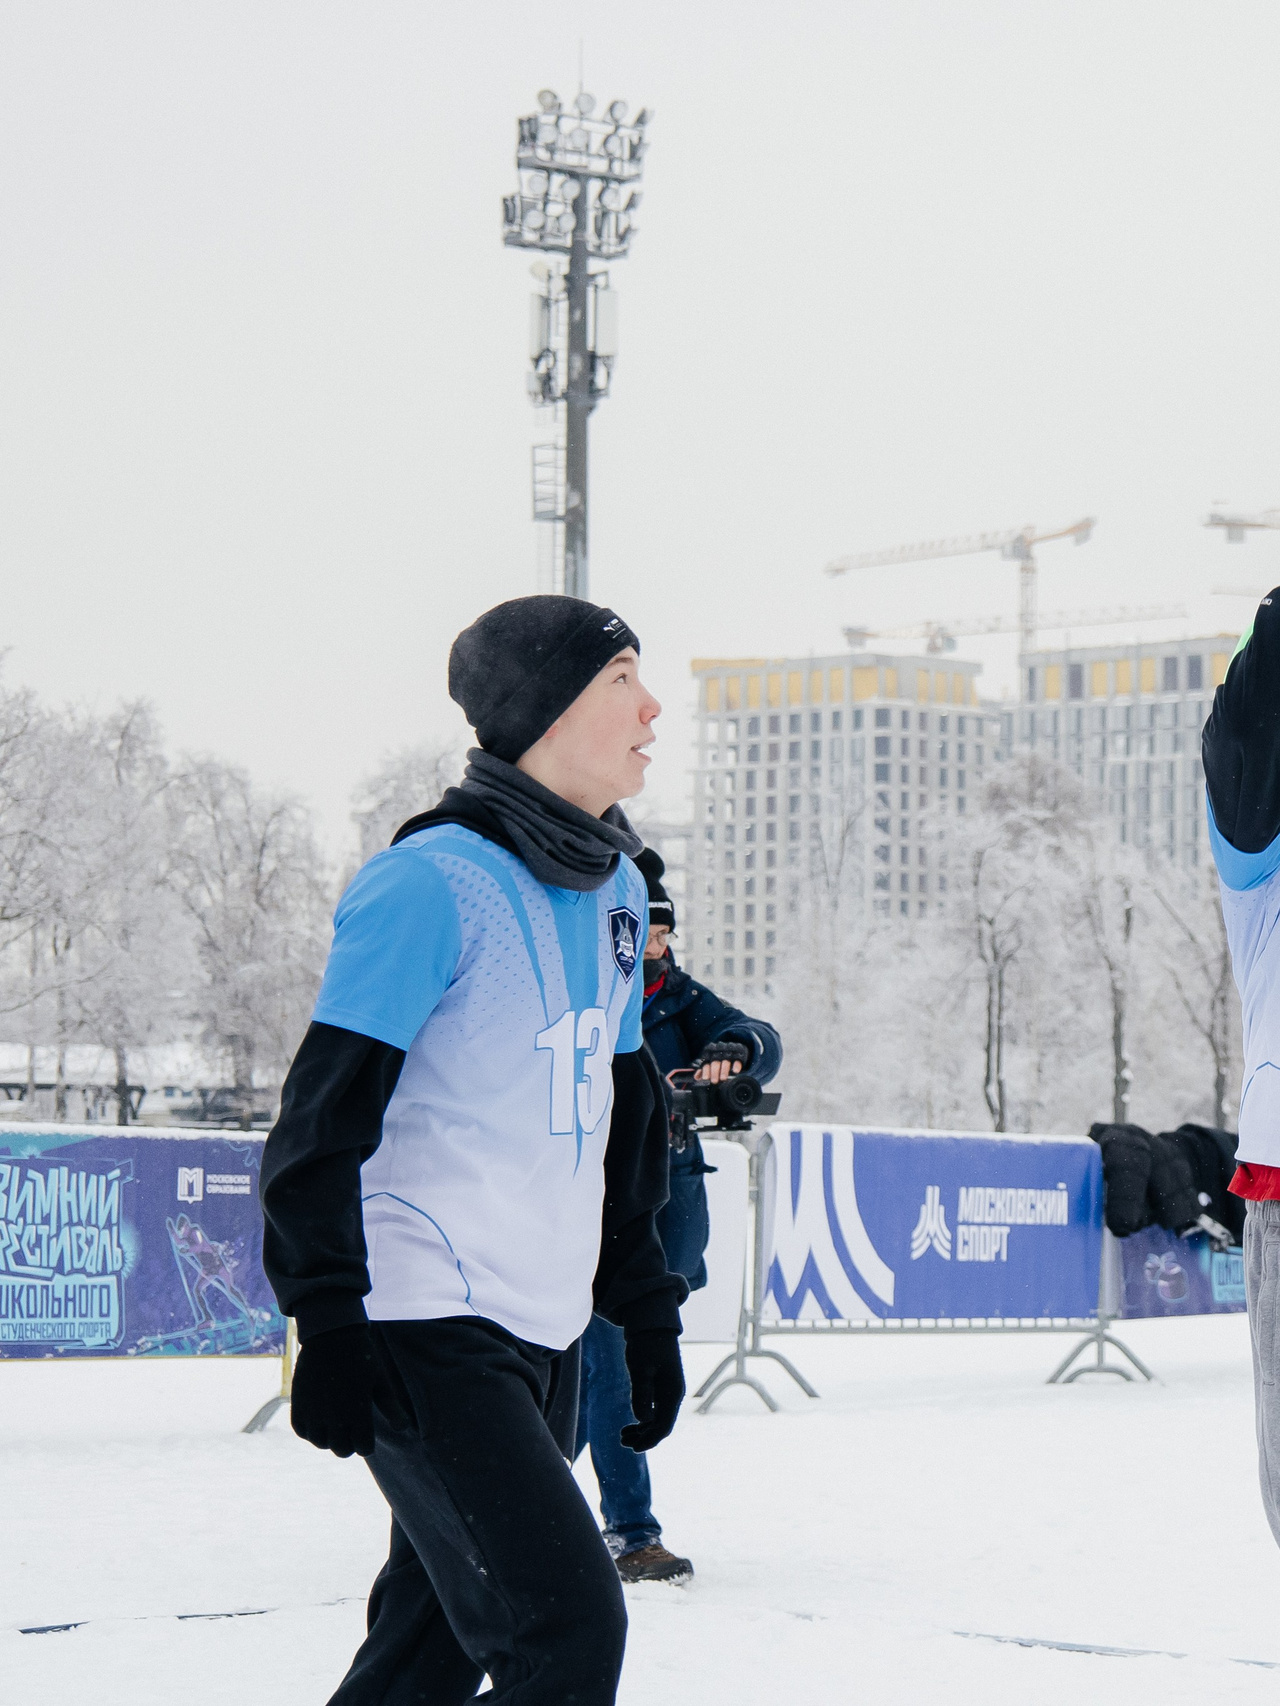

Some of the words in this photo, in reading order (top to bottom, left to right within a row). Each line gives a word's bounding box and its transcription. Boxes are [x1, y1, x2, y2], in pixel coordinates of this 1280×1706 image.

[534, 1006, 615, 1136] 13
[957, 1181, 1069, 1226] МОСКОВСКИЙ
[956, 1224, 1011, 1263] СПОРТ
[0, 1322, 75, 1340] СТУДЕНЧЕСКОГО
[78, 1322, 112, 1339] СПОРТА
